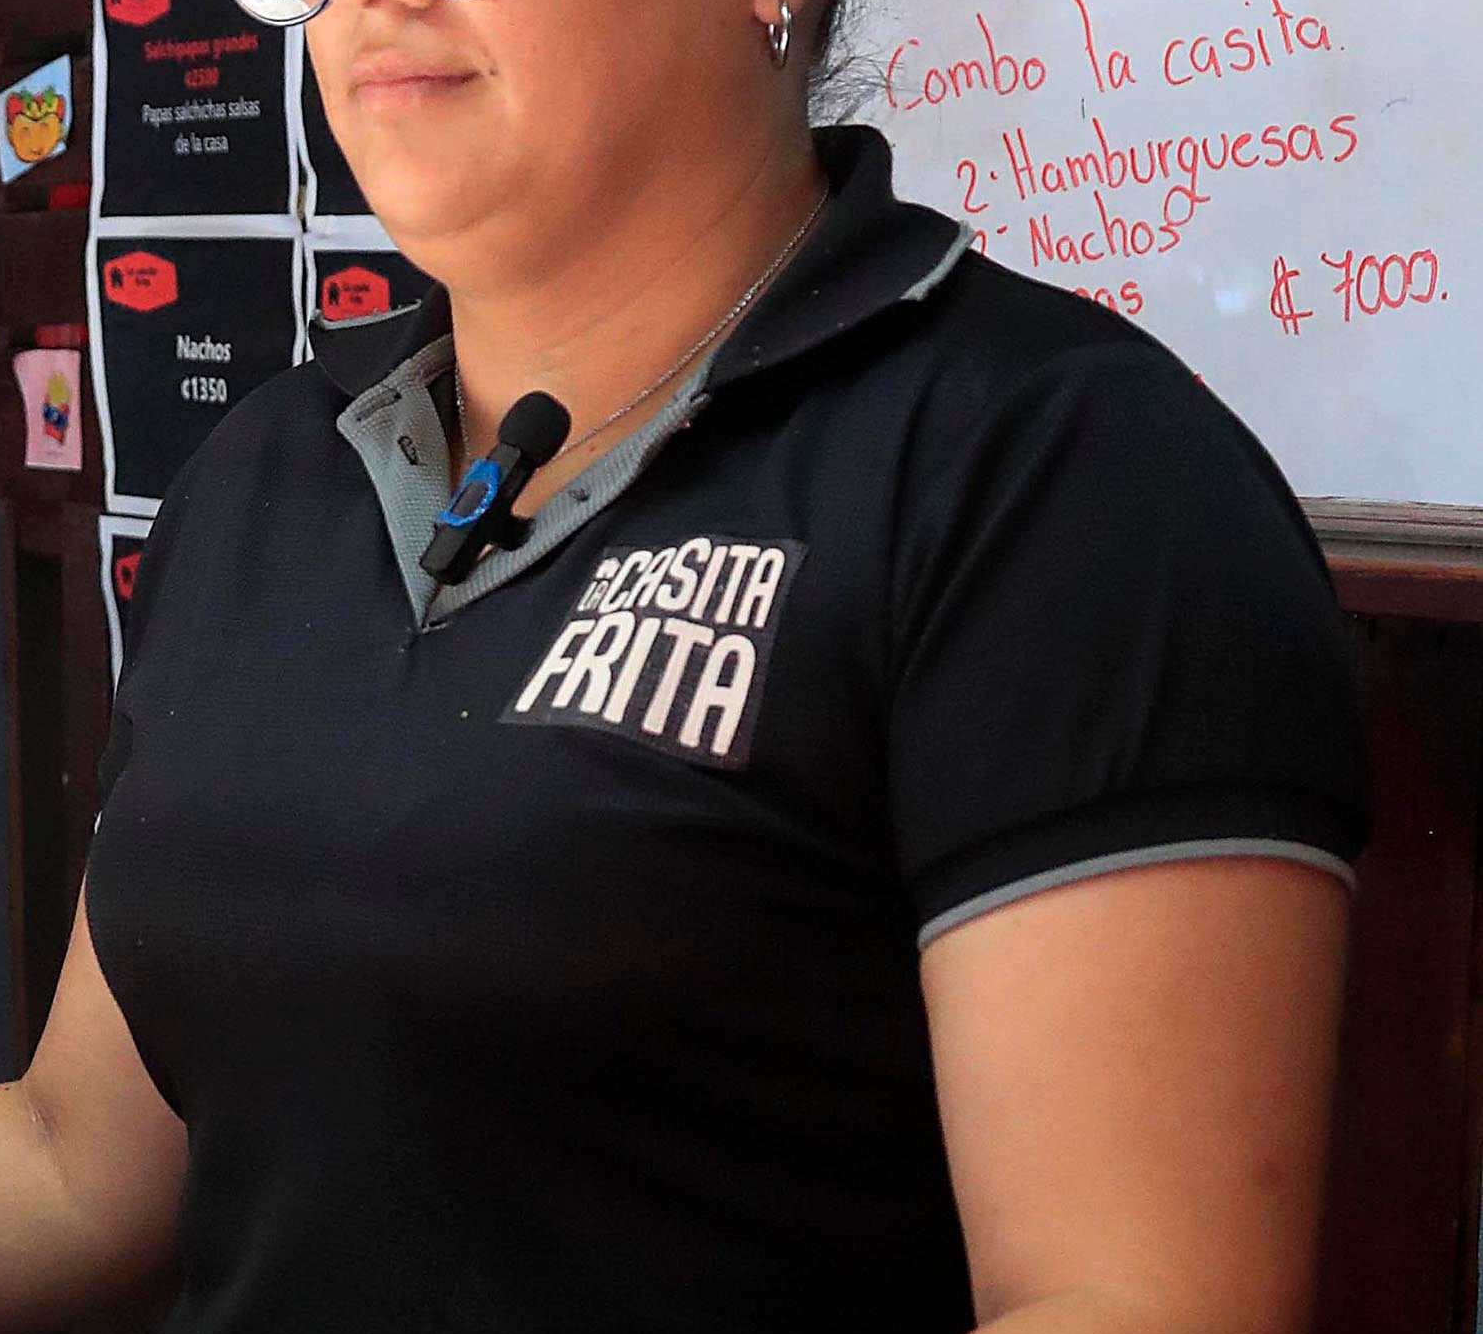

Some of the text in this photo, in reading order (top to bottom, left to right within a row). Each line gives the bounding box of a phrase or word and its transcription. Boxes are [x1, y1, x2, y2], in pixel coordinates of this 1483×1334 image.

[886, 12, 1047, 111] Combo
[174, 132, 229, 155] de la casa
[1003, 114, 1358, 227] Hamburguesas
[1028, 190, 1182, 267] Nachos
[176, 334, 232, 363] Nachos
[577, 536, 786, 629] LA CASITA
[515, 609, 757, 757] FRITA
